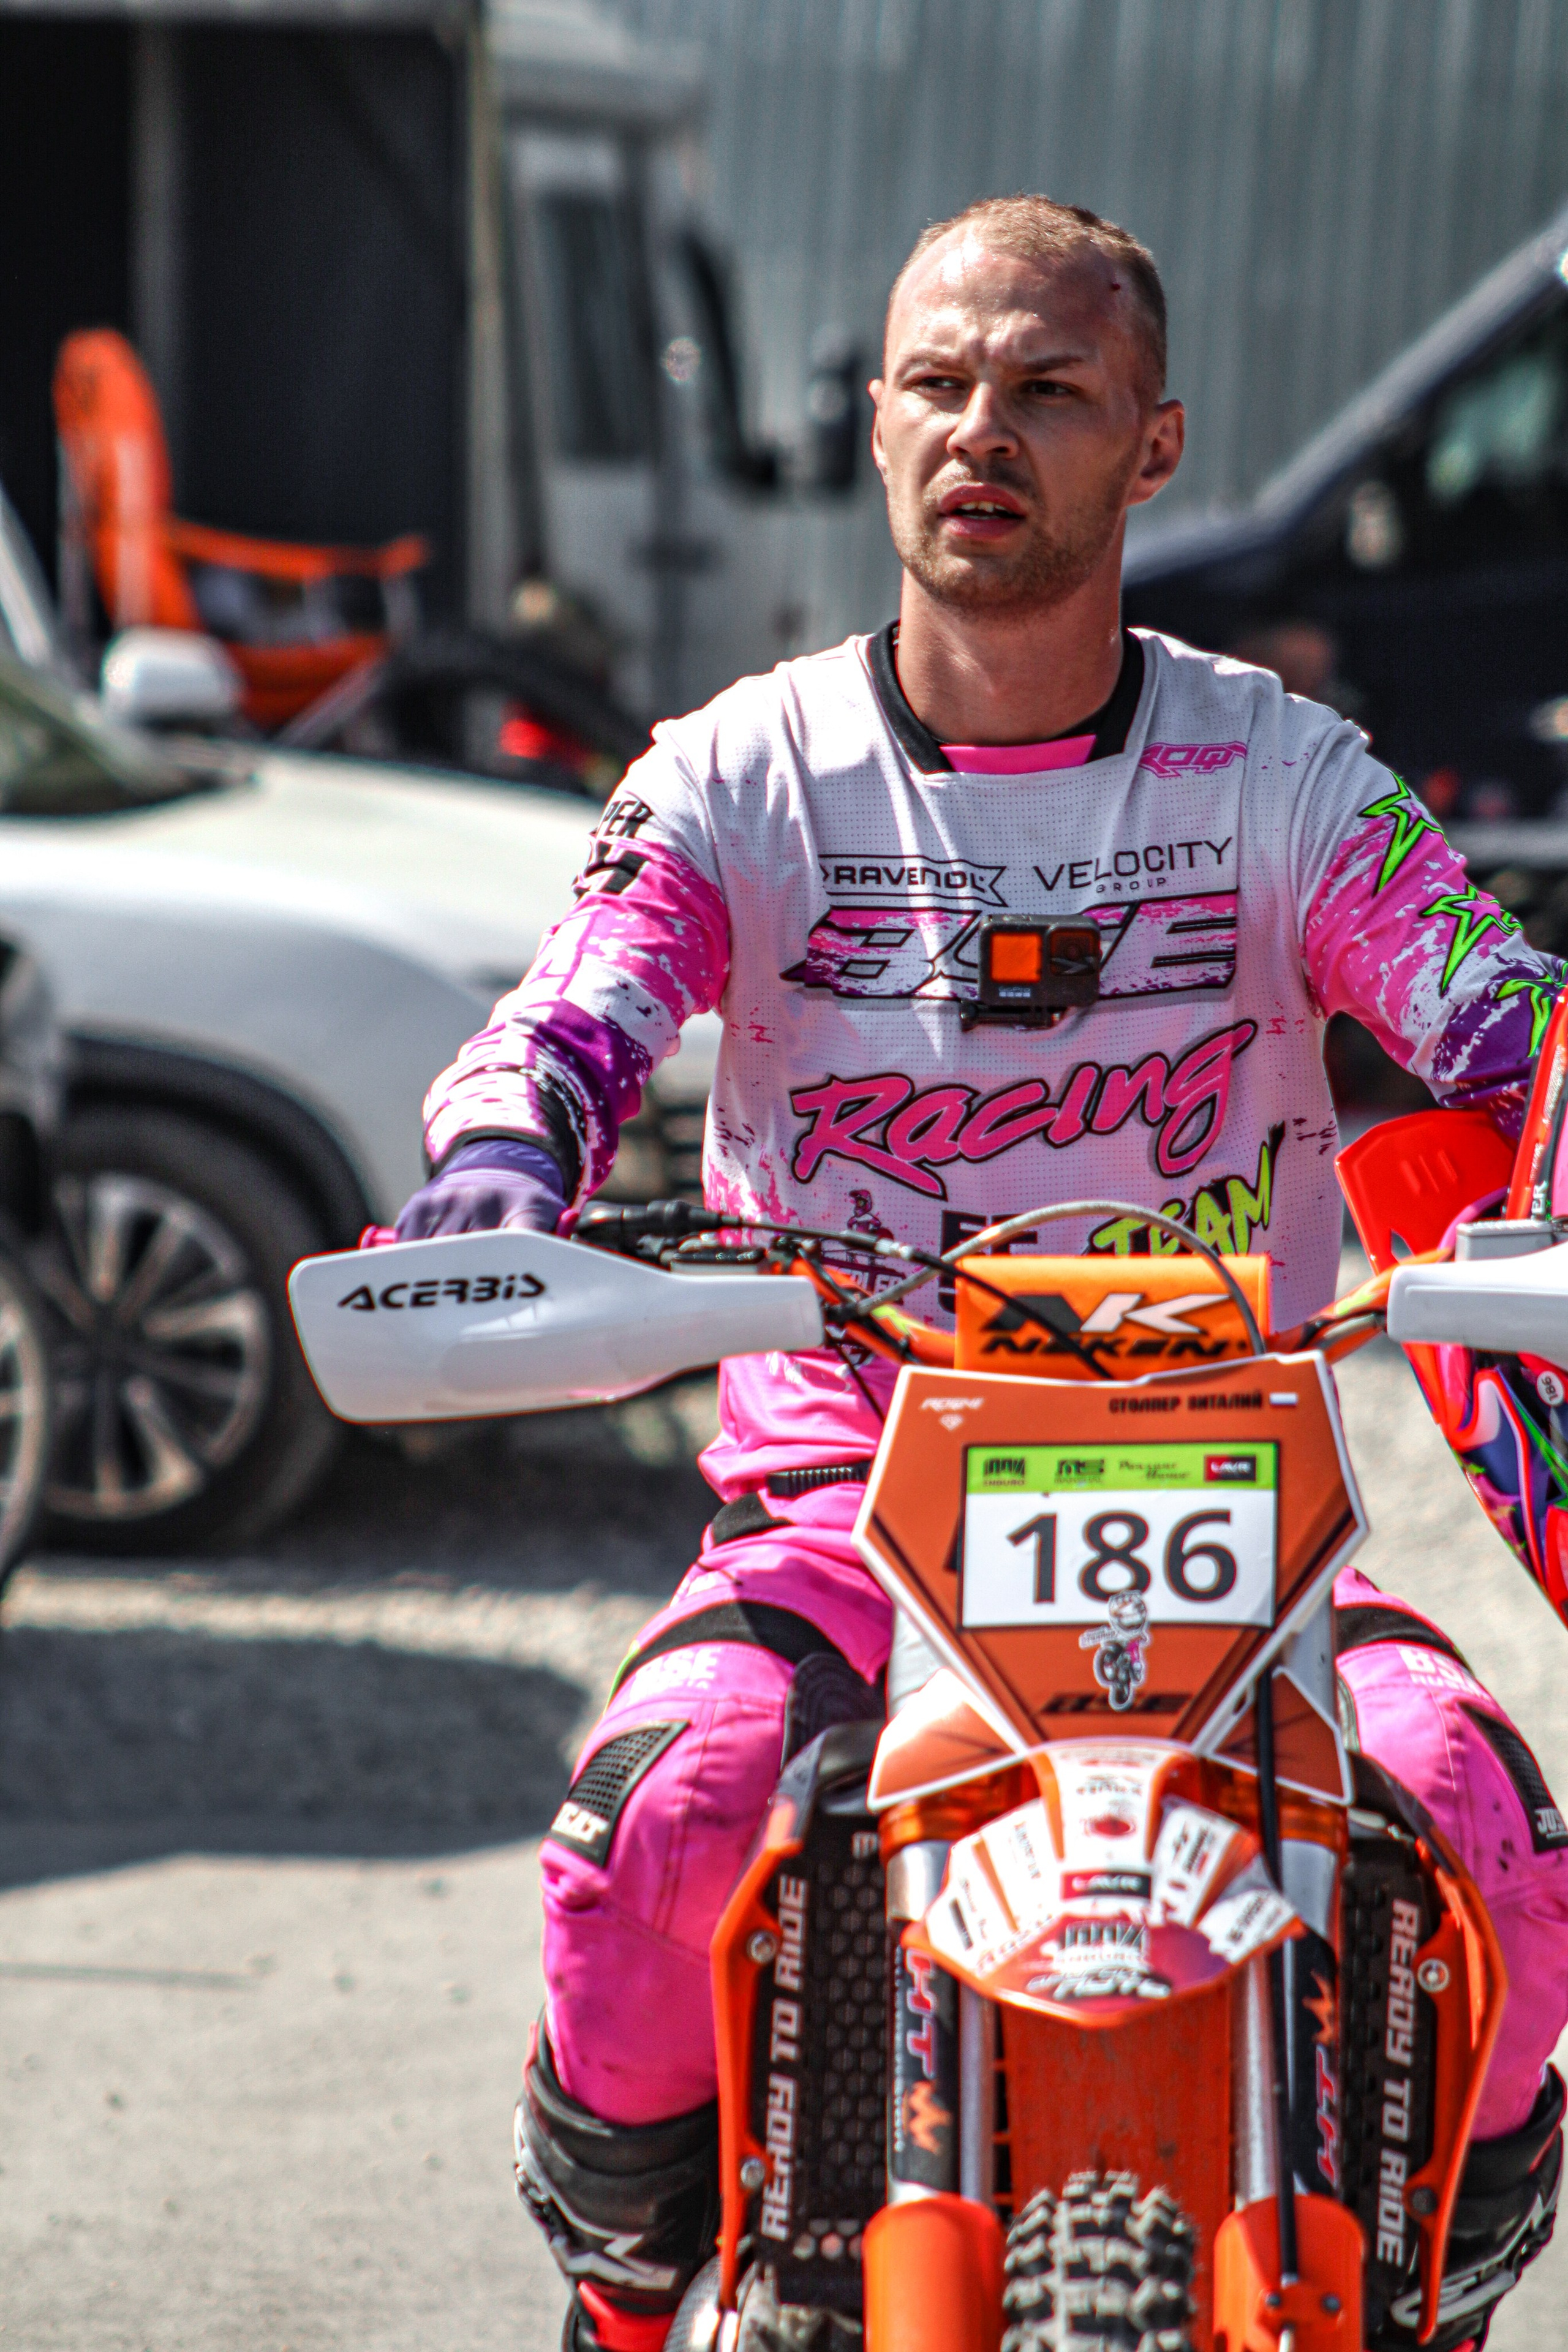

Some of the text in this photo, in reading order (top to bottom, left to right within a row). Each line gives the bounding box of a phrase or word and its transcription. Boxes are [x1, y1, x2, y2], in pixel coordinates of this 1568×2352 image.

[833, 865, 986, 894] RAVENOL
[1033, 837, 1233, 891] VELOCITY
[1096, 876, 1166, 893] GROUP
[790, 1019, 1257, 1201] Racing
[1541, 1375, 1558, 1402] 186
[1006, 1509, 1238, 1605] 186
[1385, 1899, 1420, 2067] READY
[769, 1997, 802, 2063] TO
[1382, 2077, 1411, 2143] TO
[760, 2074, 796, 2241] READY
